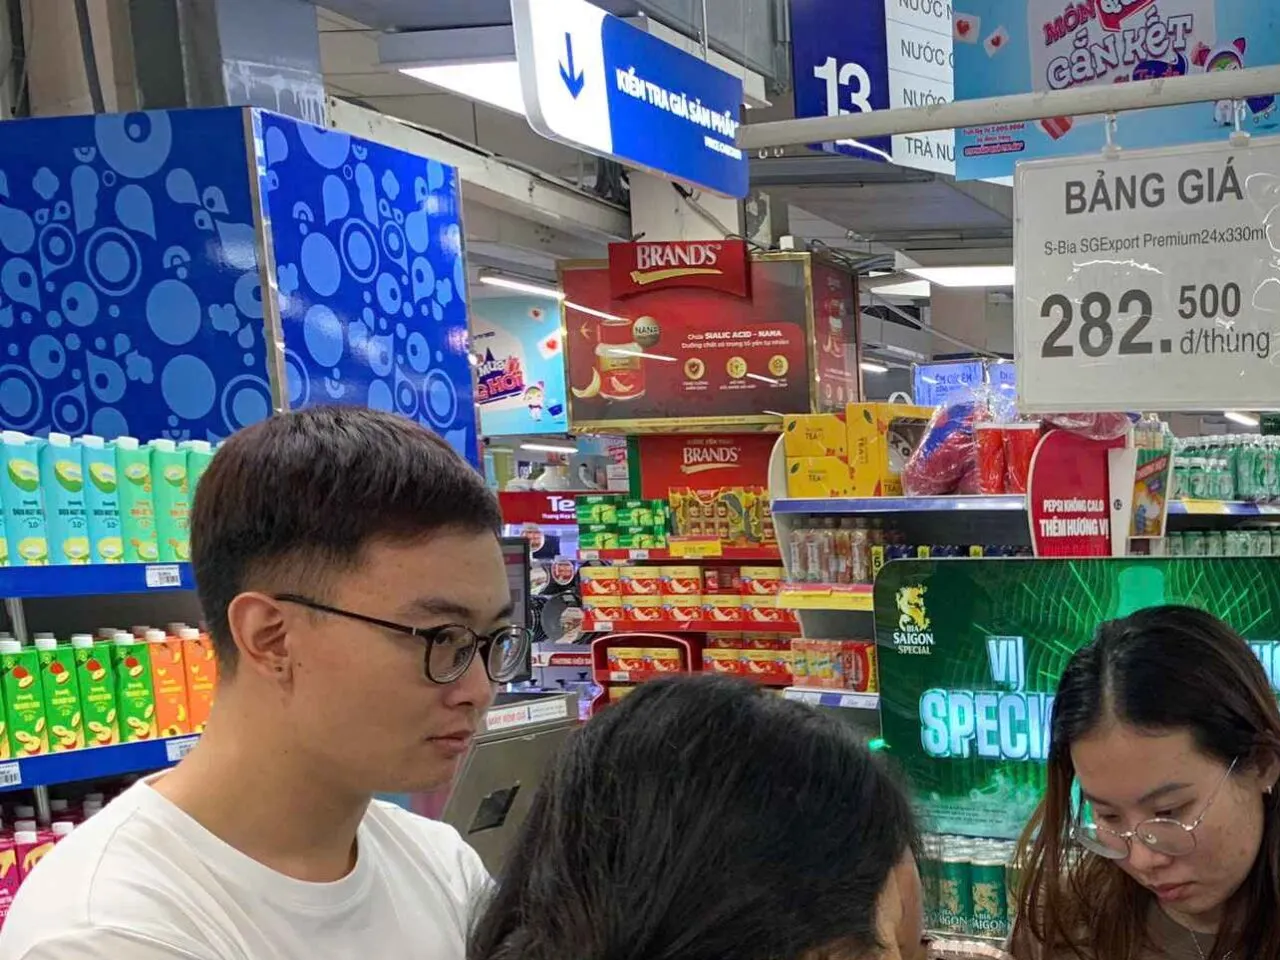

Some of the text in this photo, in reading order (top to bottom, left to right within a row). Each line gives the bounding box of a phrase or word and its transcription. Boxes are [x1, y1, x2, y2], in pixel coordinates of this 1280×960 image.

[901, 40, 945, 67] NƯỚC
[645, 81, 670, 111] TRA
[813, 56, 873, 118] 13
[905, 136, 934, 159] TRÀ
[1065, 156, 1244, 214] BẢNG GIÁ
[1044, 239, 1077, 256] S-Bia
[1080, 235, 1140, 254] SGExport
[1178, 282, 1241, 319] 500
[1180, 326, 1270, 359] đ/thùng
[1043, 499, 1063, 512] PEPSI
[1040, 516, 1066, 537] THÊM
[893, 632, 935, 645] SAIGON
[898, 645, 932, 655] SPECIAL
[919, 688, 1055, 760] SPECI
